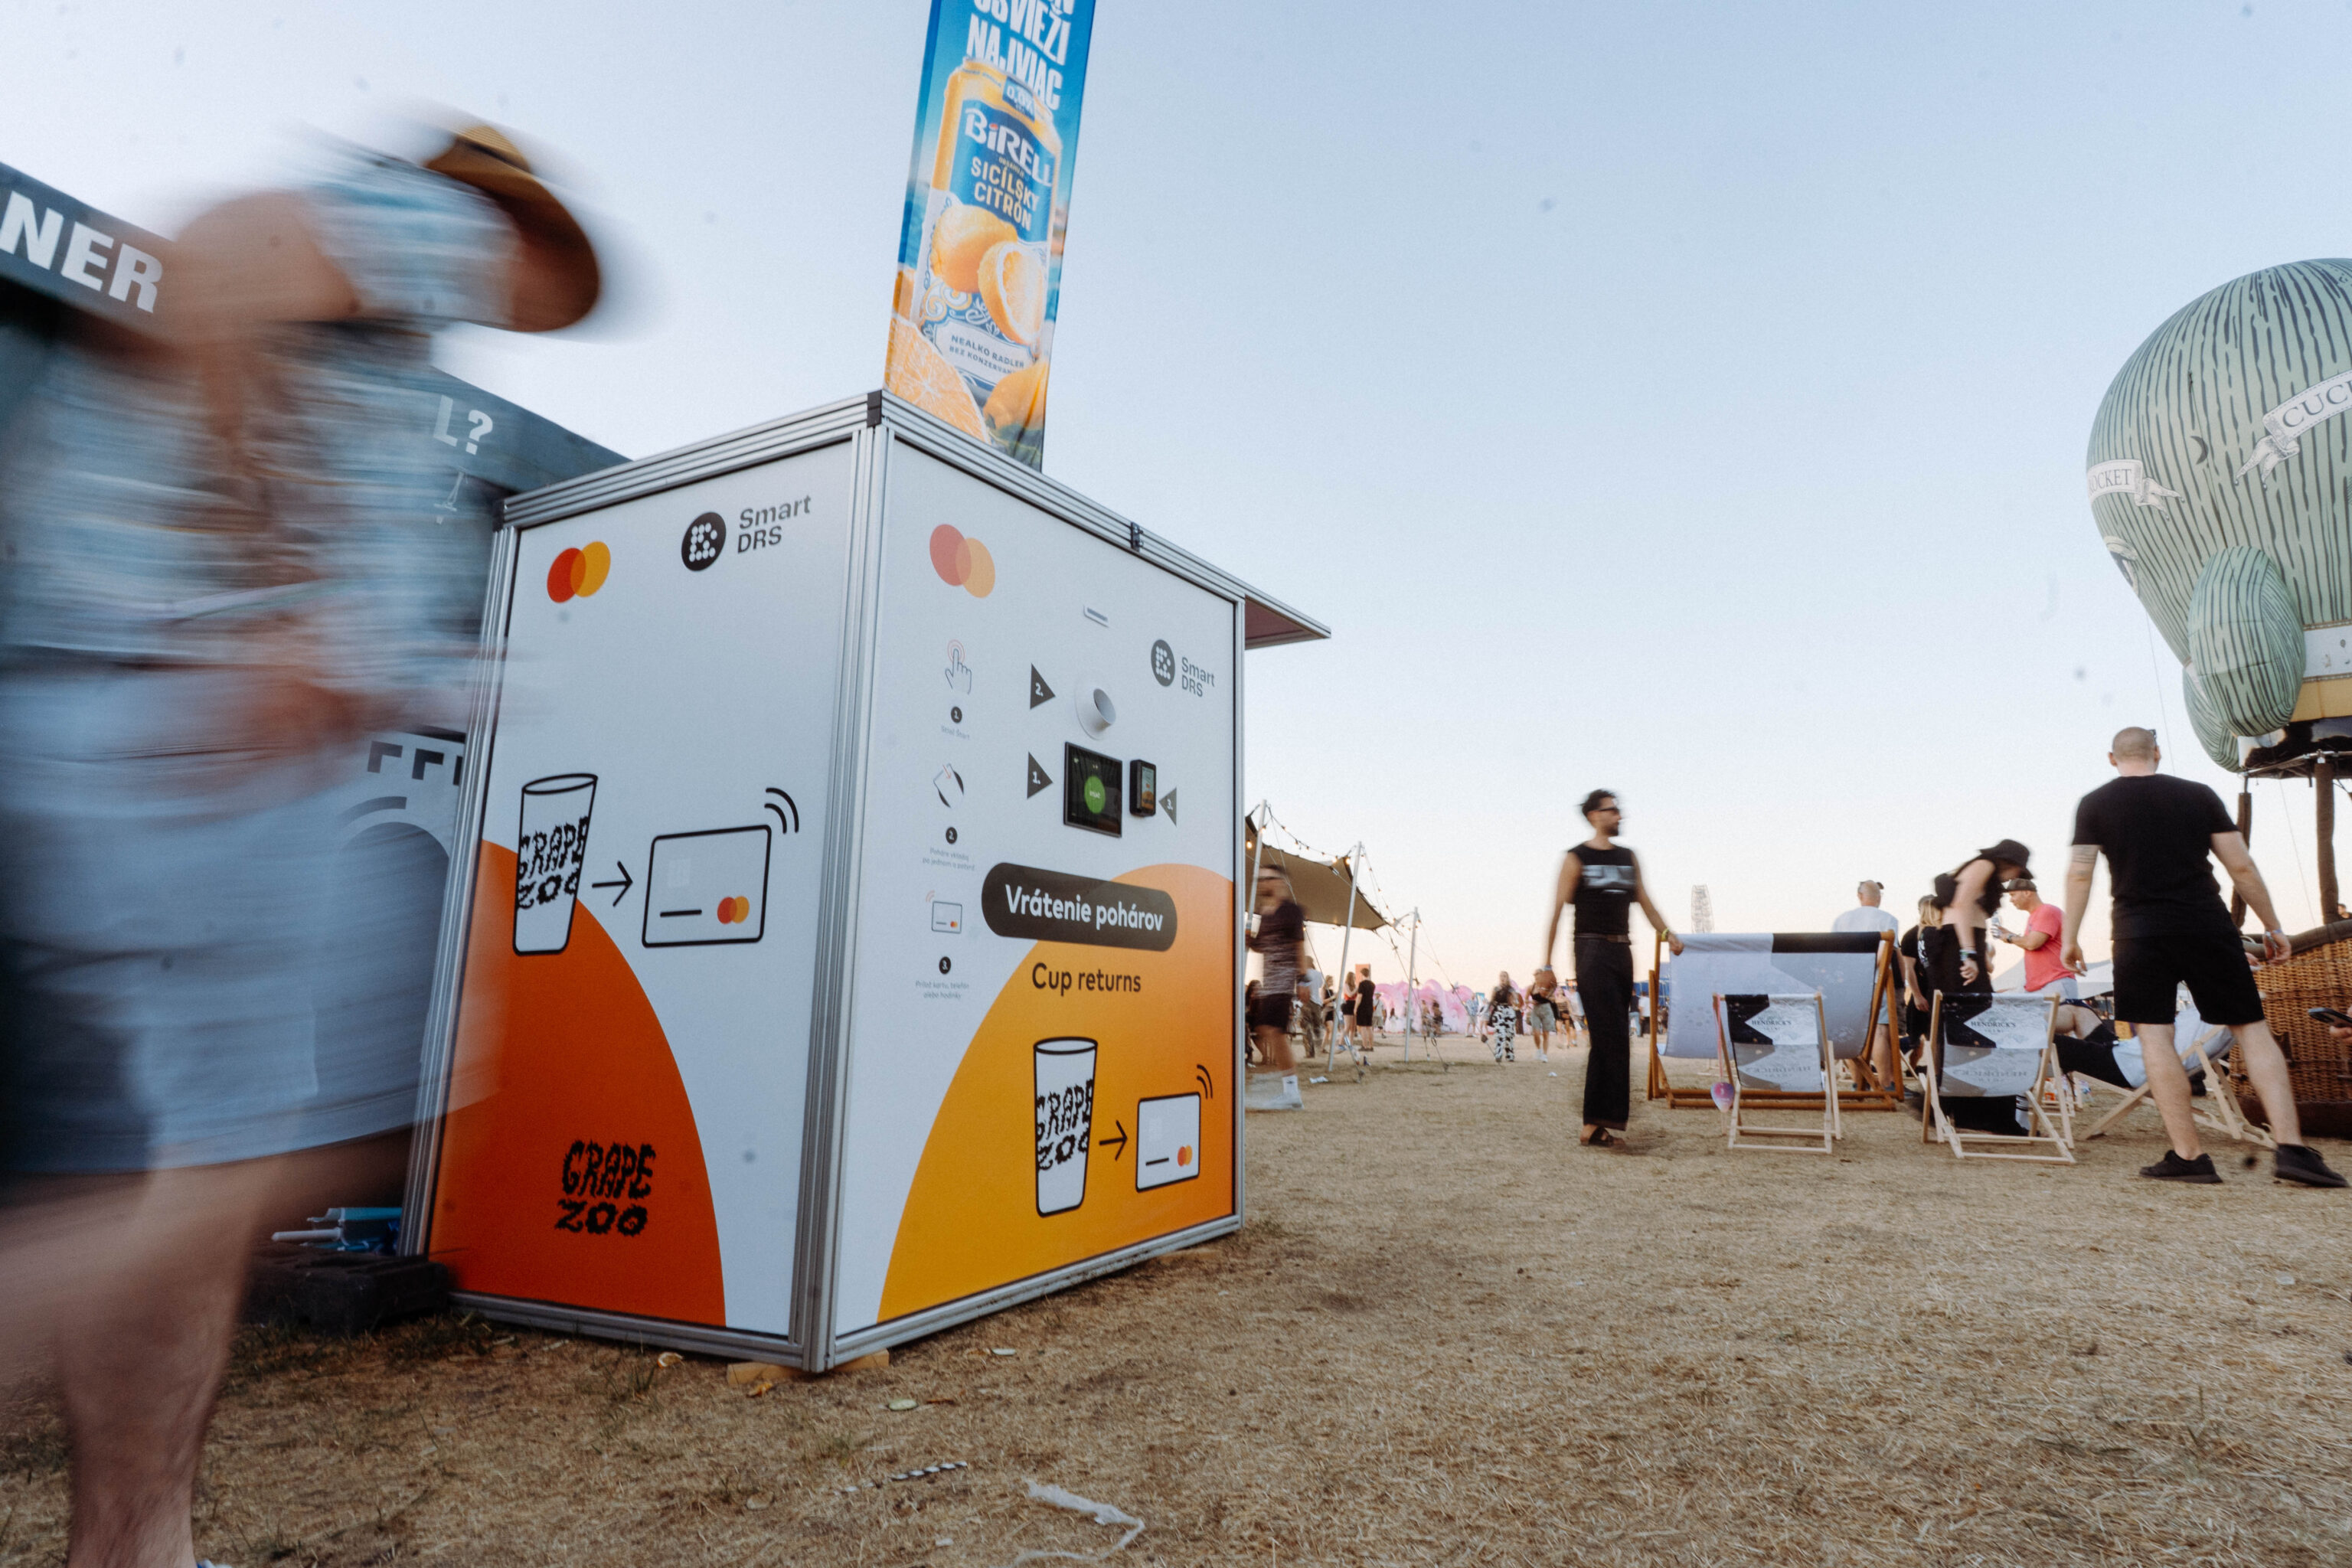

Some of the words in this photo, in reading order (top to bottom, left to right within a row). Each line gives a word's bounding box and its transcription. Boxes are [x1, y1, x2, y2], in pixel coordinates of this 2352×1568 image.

[966, 12, 1063, 111] NAJVIAC
[974, 181, 1032, 231] CITRÓN
[949, 345, 965, 355] BEZ
[951, 335, 990, 356] NEALKO
[991, 352, 1024, 368] RADLER
[739, 495, 811, 530] Smart
[738, 525, 782, 554] DRS
[1181, 656, 1215, 688] Smart
[1181, 674, 1203, 697] DRS
[1005, 884, 1091, 923] Vrátenie
[1096, 900, 1163, 931] pohárov
[1032, 962, 1072, 997] Cup
[1078, 969, 1142, 993] returns
[562, 1139, 656, 1199] GRAPE
[555, 1198, 648, 1236] ZOO
